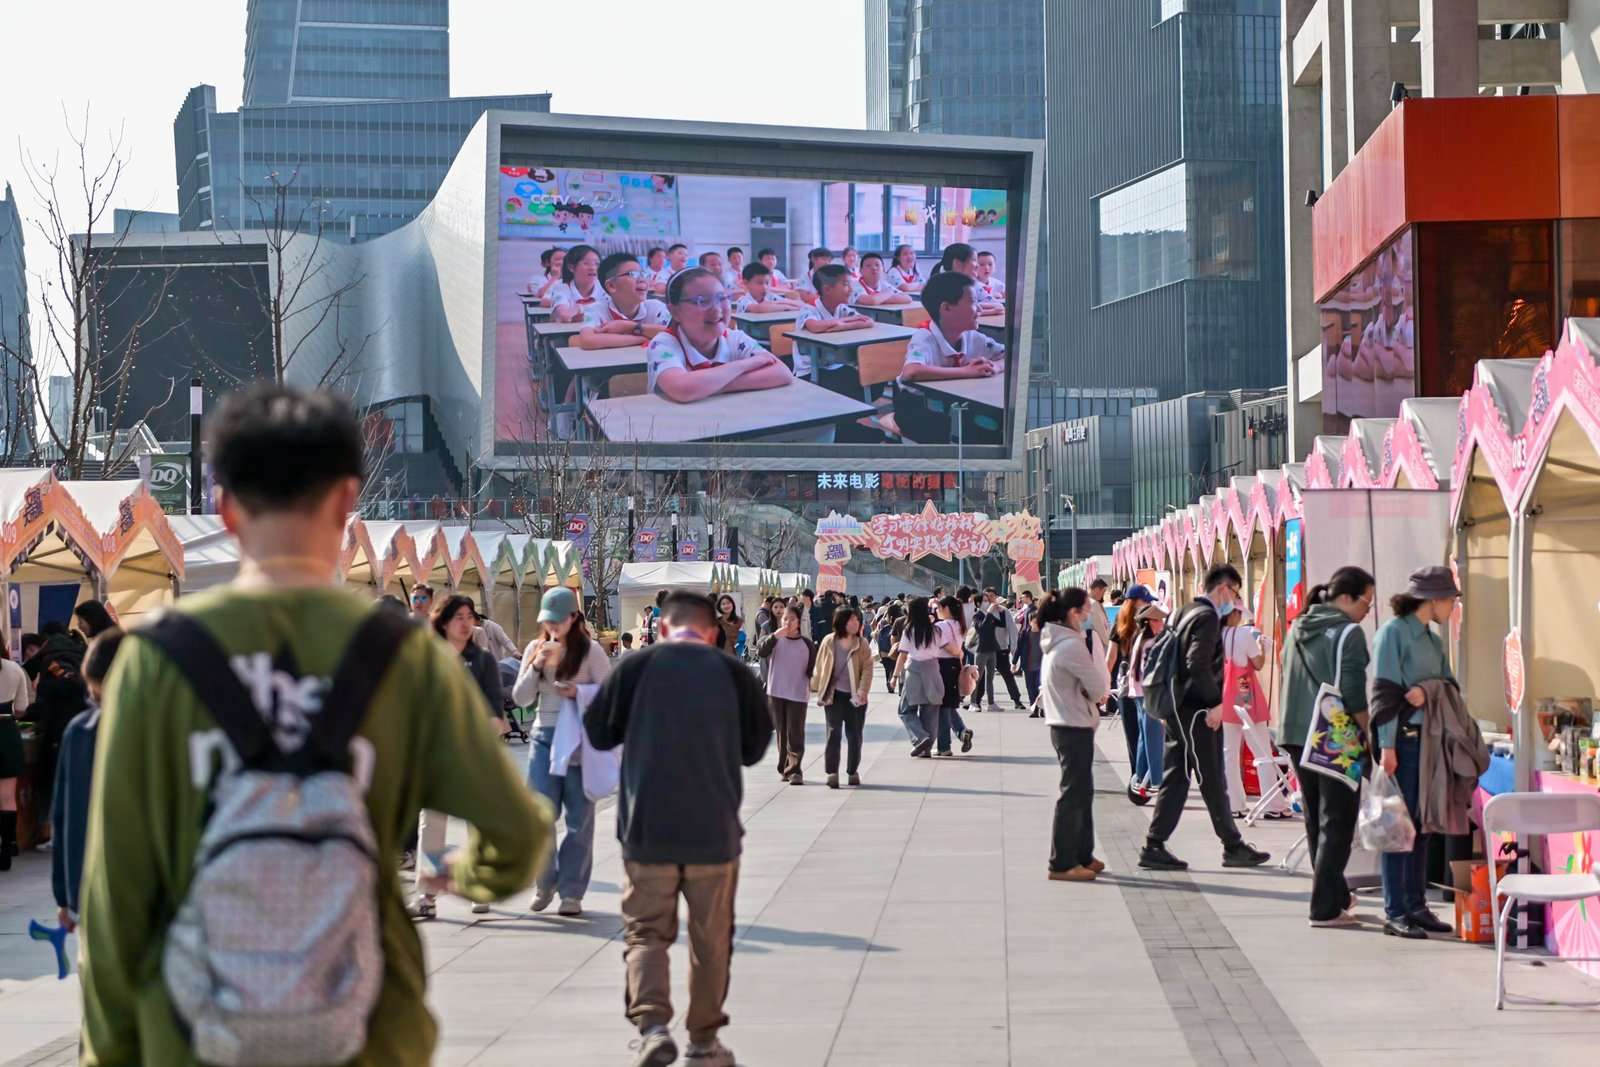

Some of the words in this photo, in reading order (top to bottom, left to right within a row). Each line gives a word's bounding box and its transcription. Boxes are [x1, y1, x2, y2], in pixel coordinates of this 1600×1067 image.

[531, 194, 570, 205] CCTV
[151, 469, 179, 484] DQ
[817, 472, 880, 489] 未来电影
